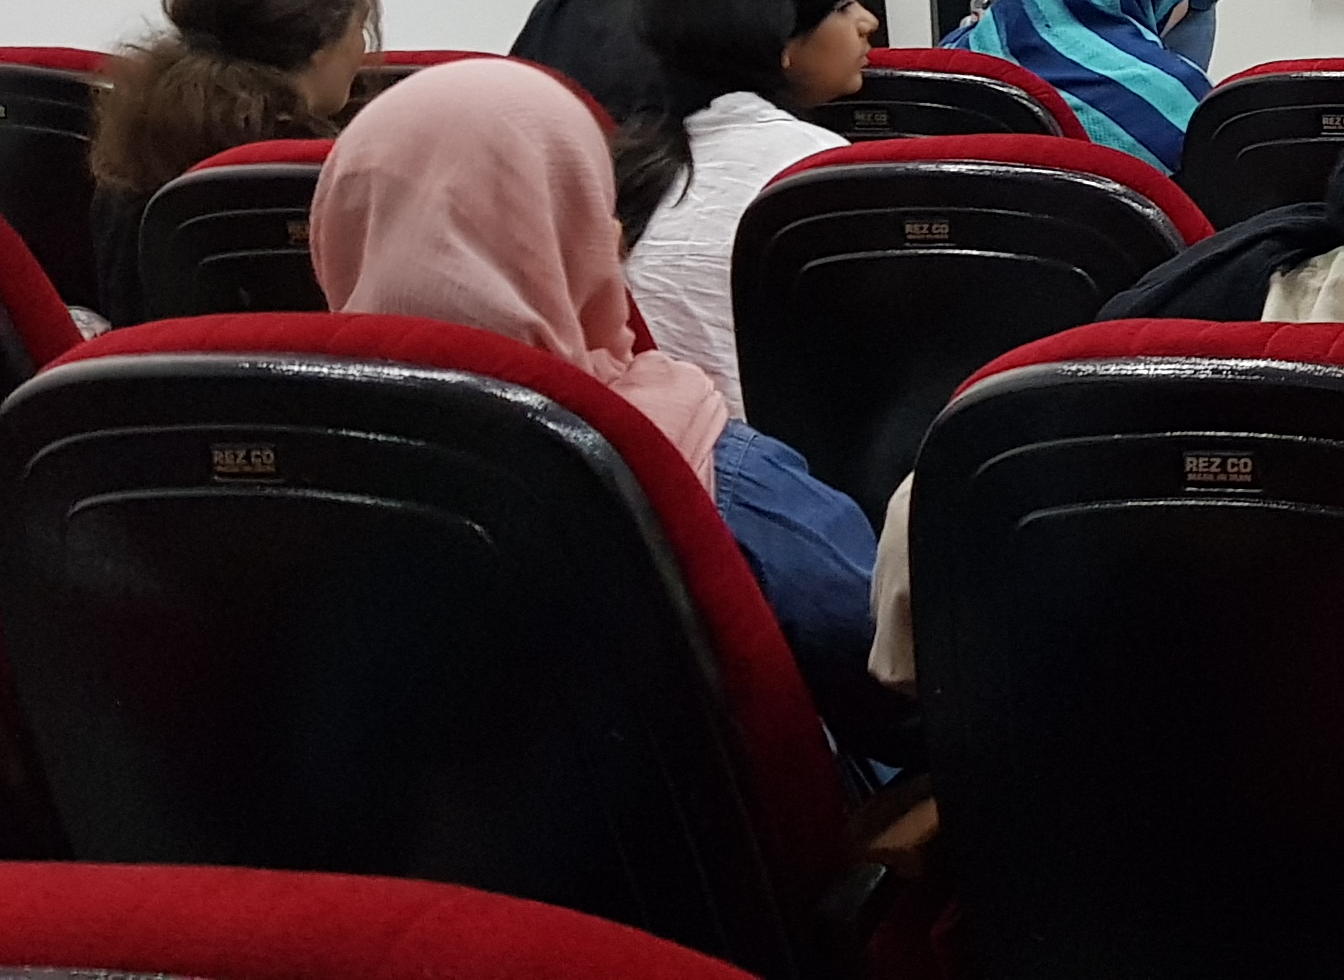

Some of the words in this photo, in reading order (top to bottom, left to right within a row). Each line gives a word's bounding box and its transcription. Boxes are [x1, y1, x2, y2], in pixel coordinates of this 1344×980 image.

[1322, 117, 1341, 125] REZ
[905, 223, 930, 234] REZ
[931, 223, 949, 234] CO
[213, 450, 247, 465] REZ
[250, 450, 275, 465] CO
[1184, 456, 1221, 473] REZ
[1226, 457, 1253, 473] CO
